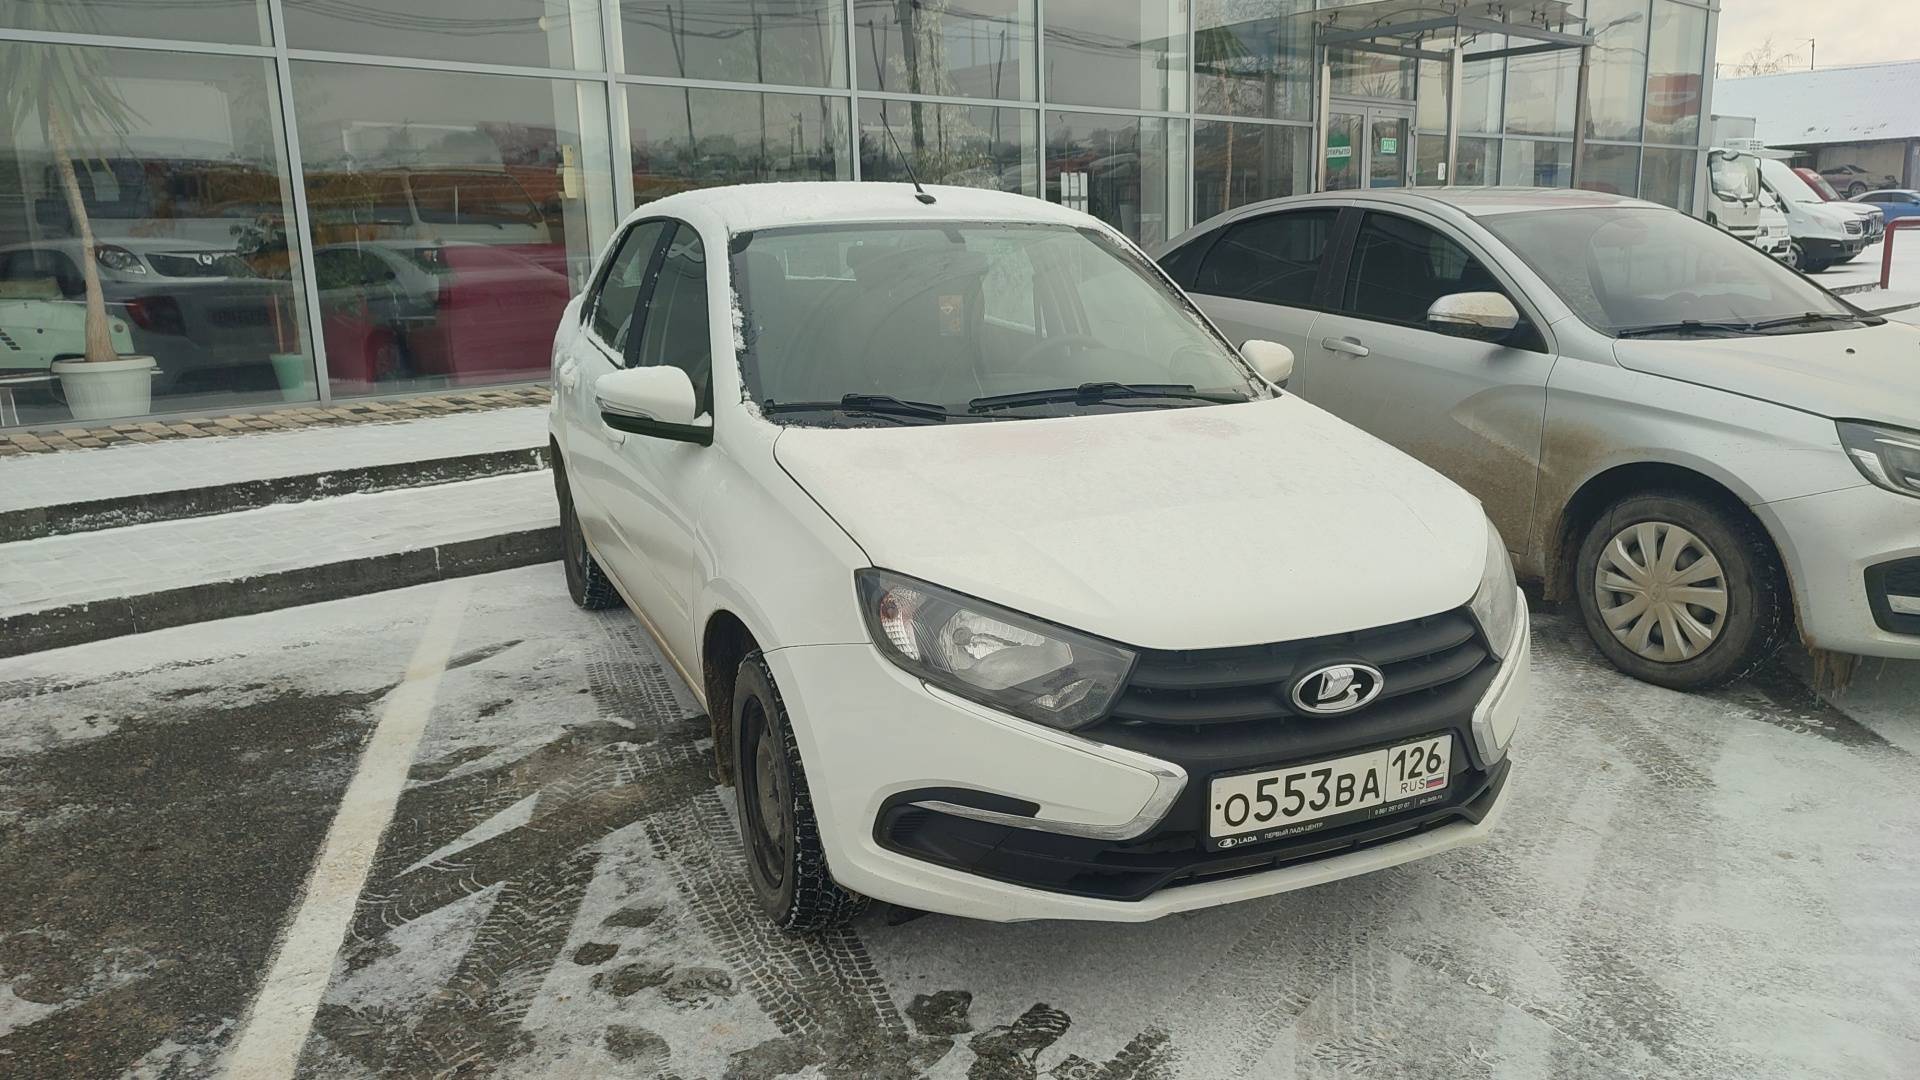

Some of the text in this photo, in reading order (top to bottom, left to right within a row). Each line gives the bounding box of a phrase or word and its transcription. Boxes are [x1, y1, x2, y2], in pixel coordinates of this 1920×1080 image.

[1224, 742, 1441, 827] О553ВА 126
[1400, 778, 1425, 794] RUS
[1238, 835, 1258, 844] LADA
[1264, 822, 1324, 840] ПЕРВЫЙ ЛАДА ЦЕНТР
